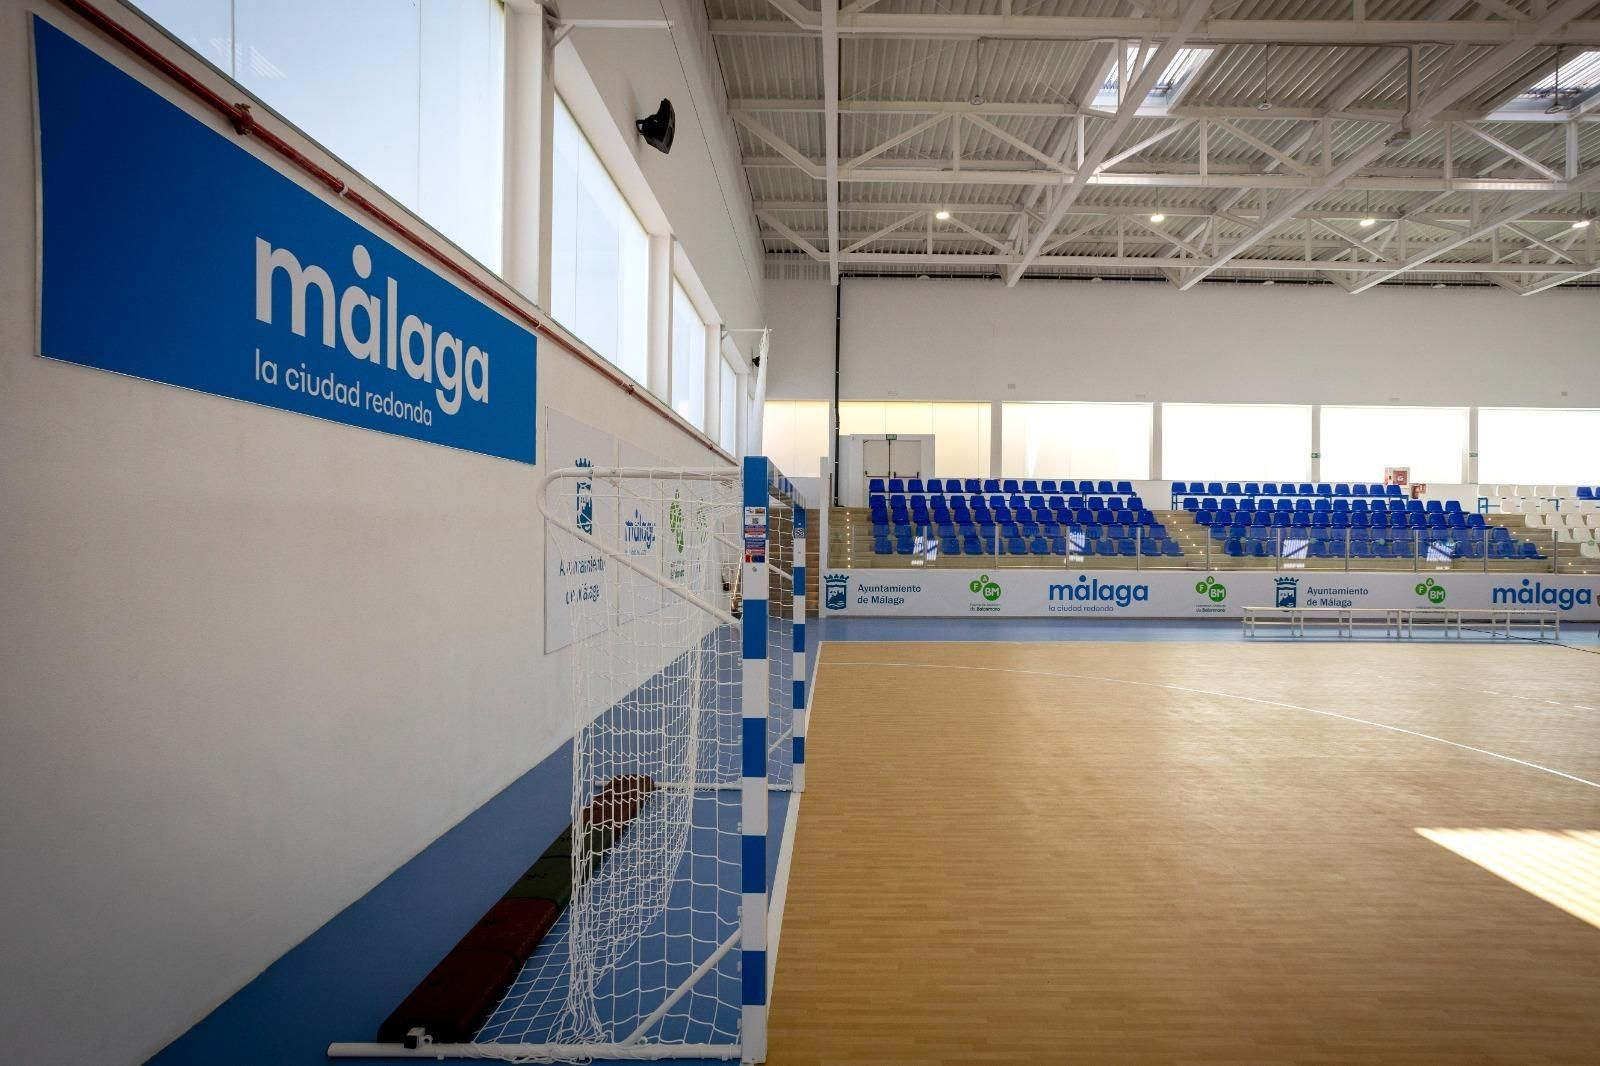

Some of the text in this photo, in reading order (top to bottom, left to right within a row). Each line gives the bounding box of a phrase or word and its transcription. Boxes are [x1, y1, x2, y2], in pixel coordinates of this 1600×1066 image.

[255, 348, 432, 427] la ciudad redonda
[857, 584, 921, 594] Ayuntamiento
[985, 587, 999, 596] BM
[1210, 588, 1225, 598] BM
[1307, 586, 1369, 596] Ayuntamiento
[857, 595, 905, 605] de Málaga
[1430, 590, 1444, 600] BM
[1306, 597, 1352, 608] de Málaga
[1057, 604, 1082, 612] ciudad
